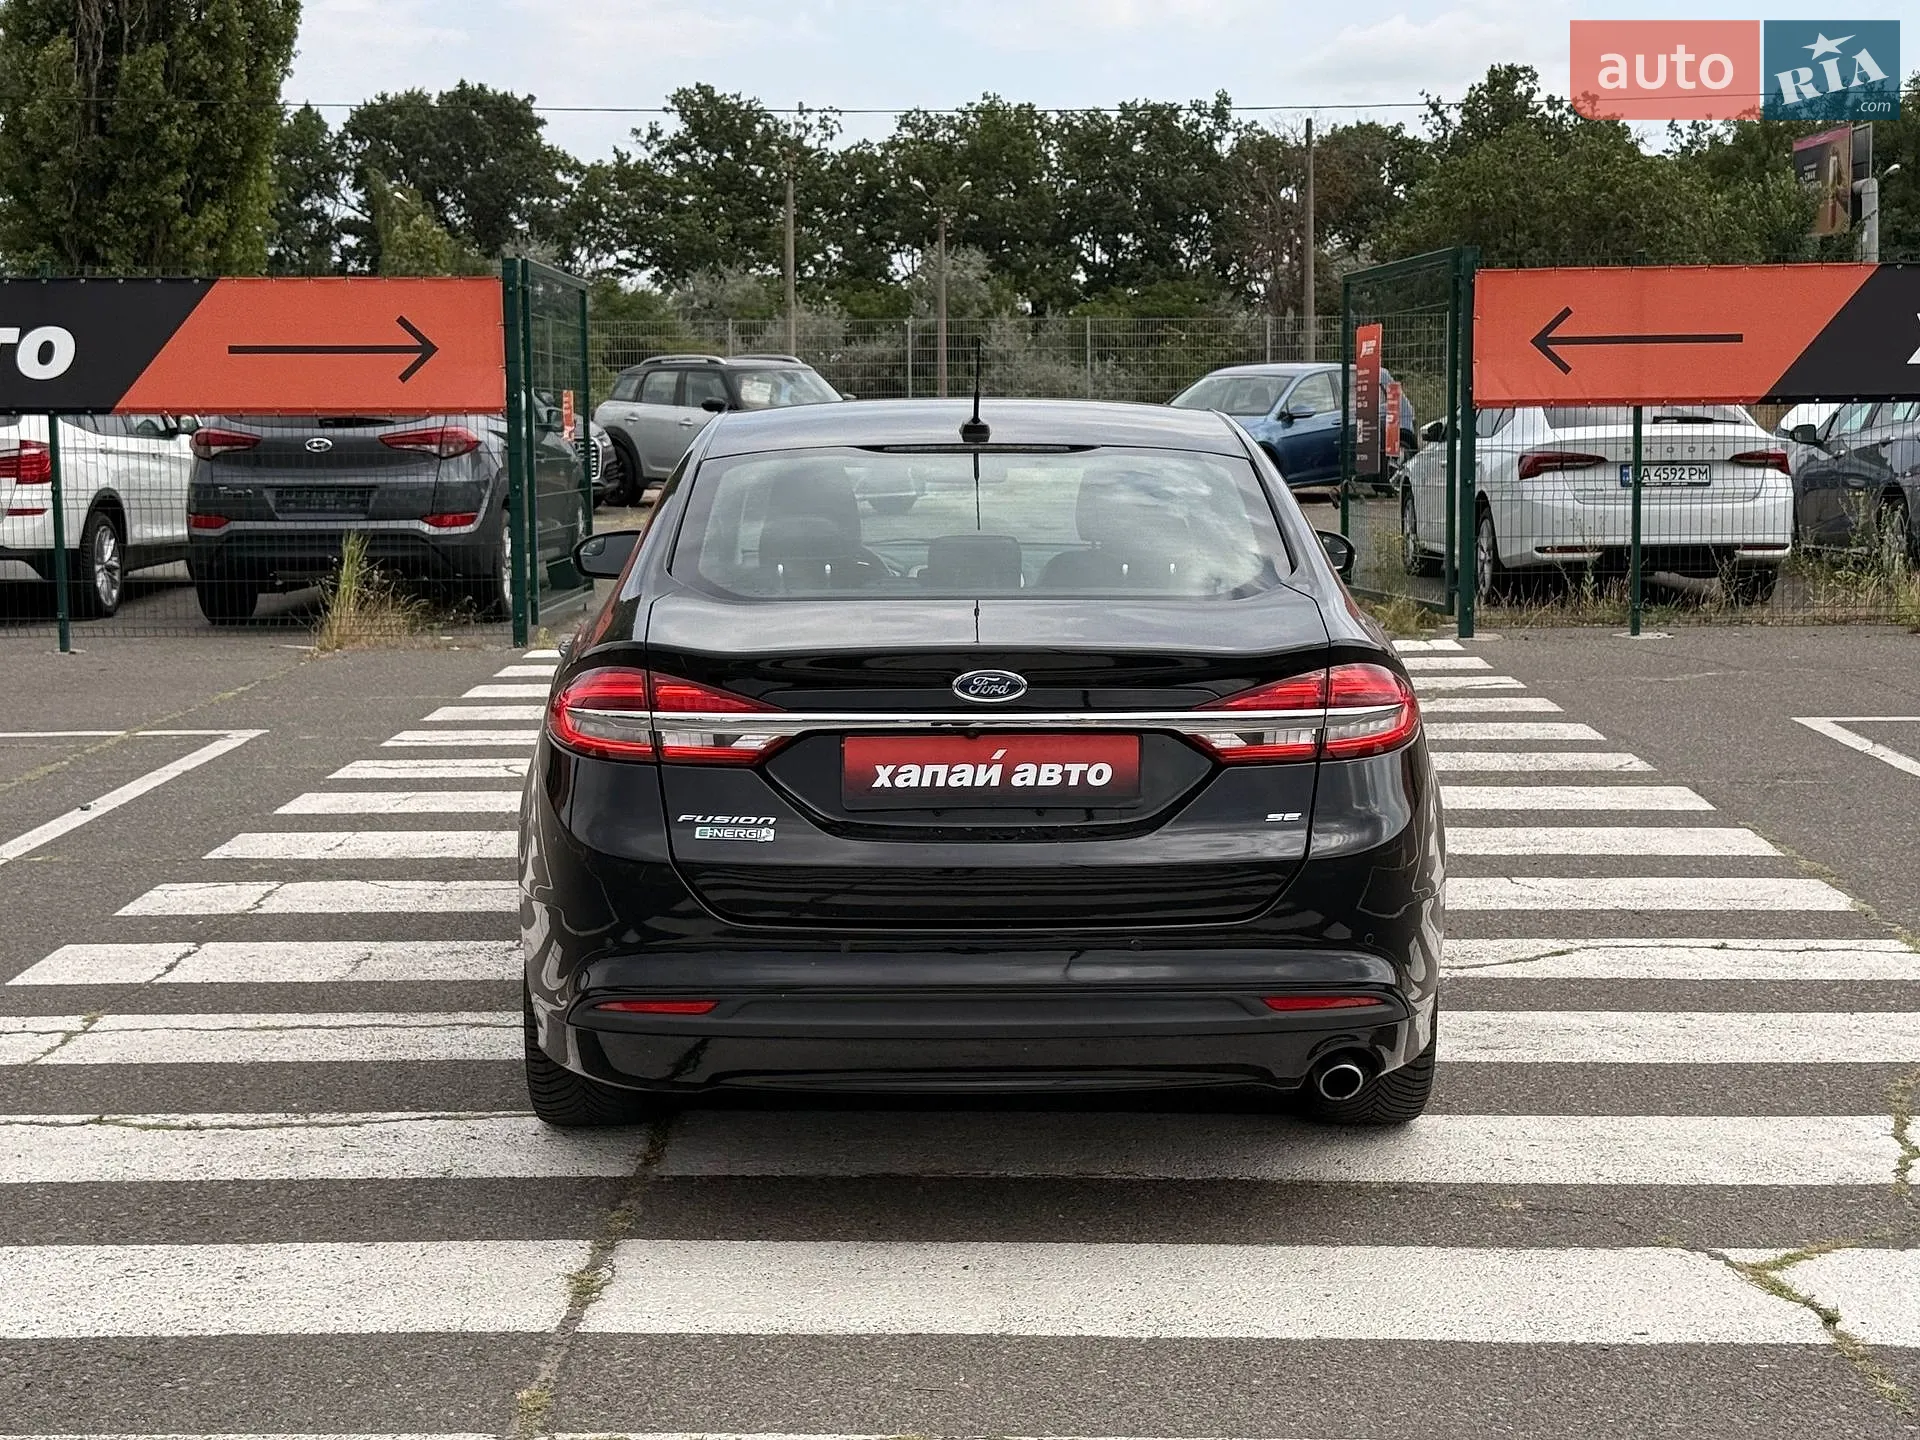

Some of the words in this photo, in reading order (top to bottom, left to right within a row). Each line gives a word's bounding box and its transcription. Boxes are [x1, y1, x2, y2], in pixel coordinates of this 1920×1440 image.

[968, 676, 1010, 694] Ford
[1010, 762, 1113, 787] авто
[677, 814, 777, 825] FUSION
[1265, 812, 1302, 822] SE
[697, 828, 763, 840] ENERGI
